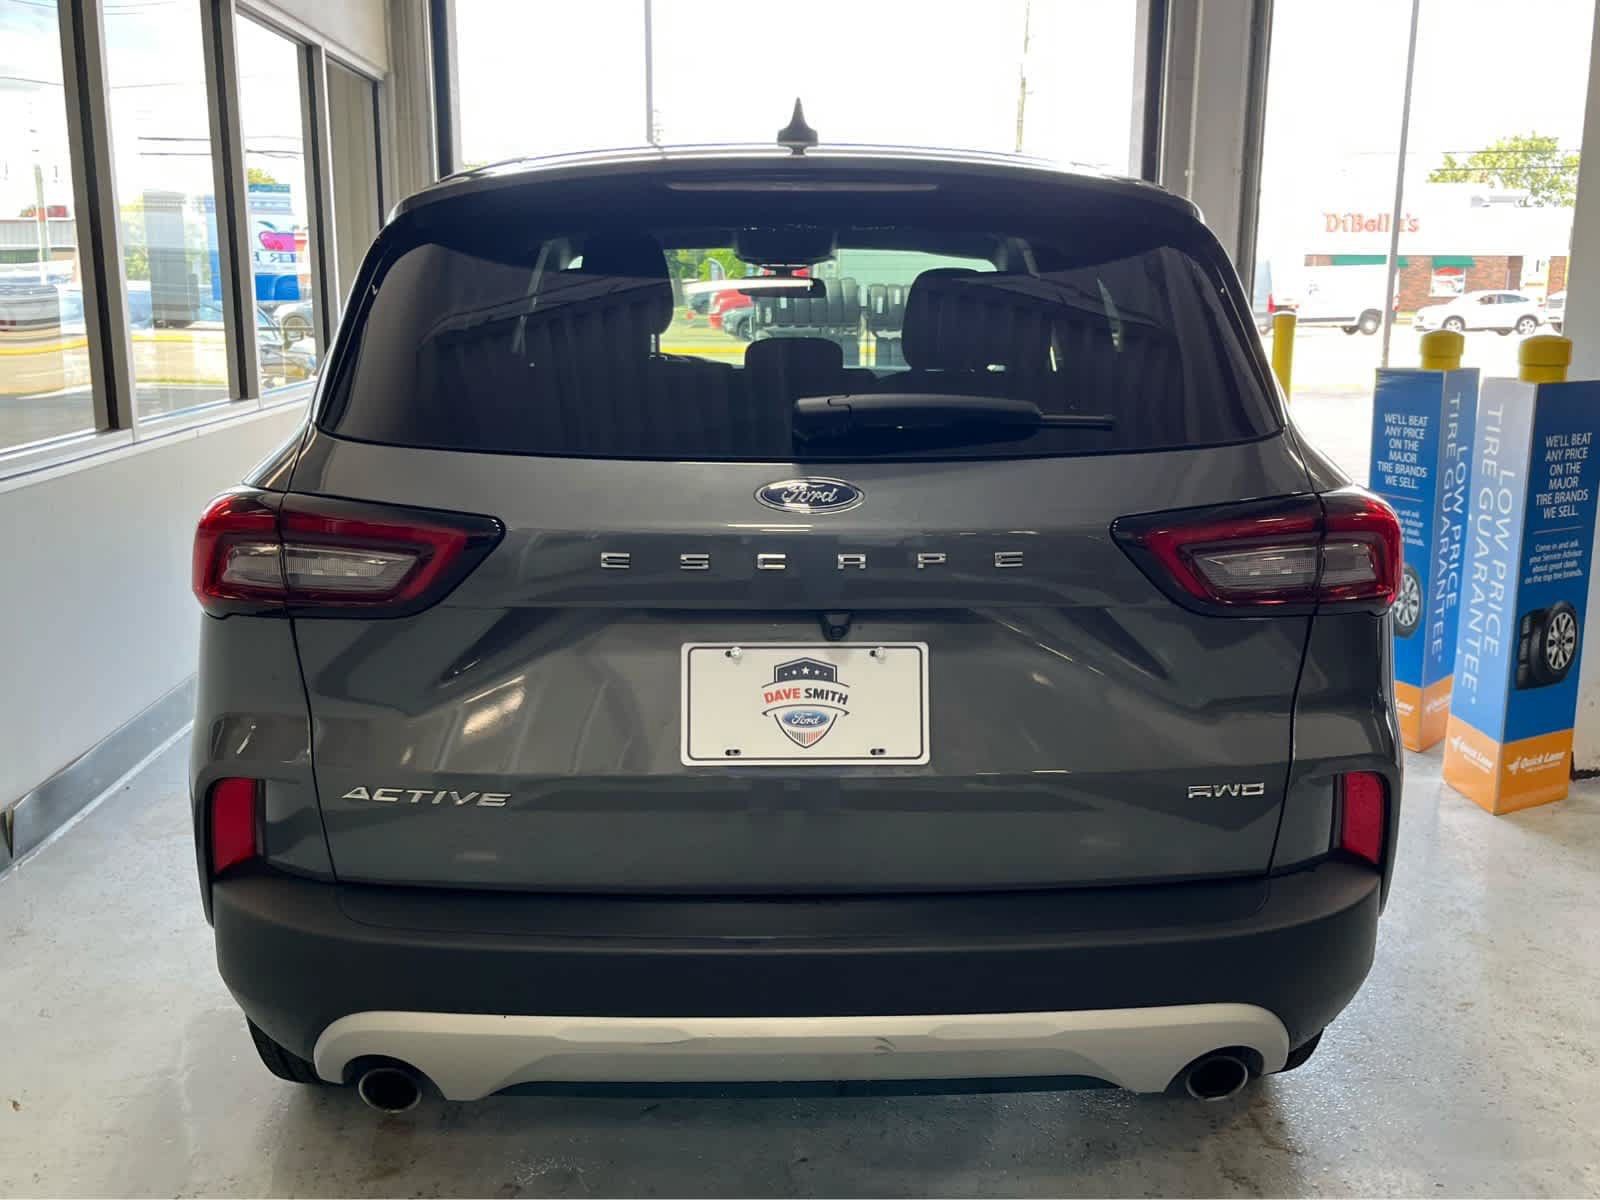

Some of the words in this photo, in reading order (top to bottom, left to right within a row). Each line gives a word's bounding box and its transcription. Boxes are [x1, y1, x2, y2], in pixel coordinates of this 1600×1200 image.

[1408, 415, 1429, 427] BEAT
[1446, 392, 1461, 459] TIRE
[1384, 425, 1402, 437] ANY
[1403, 427, 1425, 440] PRICE
[1480, 402, 1504, 479] TIRE
[1571, 432, 1592, 446] BEAT
[1388, 438, 1402, 449] ON
[1403, 439, 1419, 452] THE
[1388, 449, 1417, 464] MAJOR
[1545, 449, 1564, 462] ANY
[1564, 447, 1588, 461] PRICE
[1377, 460, 1393, 473] TIRE
[1394, 463, 1428, 478] BRANDS
[1549, 463, 1563, 476] ON
[1565, 462, 1582, 475] THE
[1384, 474, 1398, 486] WE
[1453, 445, 1468, 513] LOW
[1549, 476, 1579, 491] MAJOR
[1536, 493, 1553, 506] TIRE
[1554, 488, 1589, 505] BRANDS
[1494, 468, 1516, 551] LOW
[1543, 507, 1557, 519] WE
[600, 552, 1024, 571] ESCAPE
[1446, 524, 1462, 609] PRICE
[1484, 559, 1507, 657] PRICE
[764, 688, 801, 704] DAVE
[804, 688, 849, 705] SMITH
[342, 786, 511, 807] ACTIVE
[1188, 783, 1265, 798] AWD
